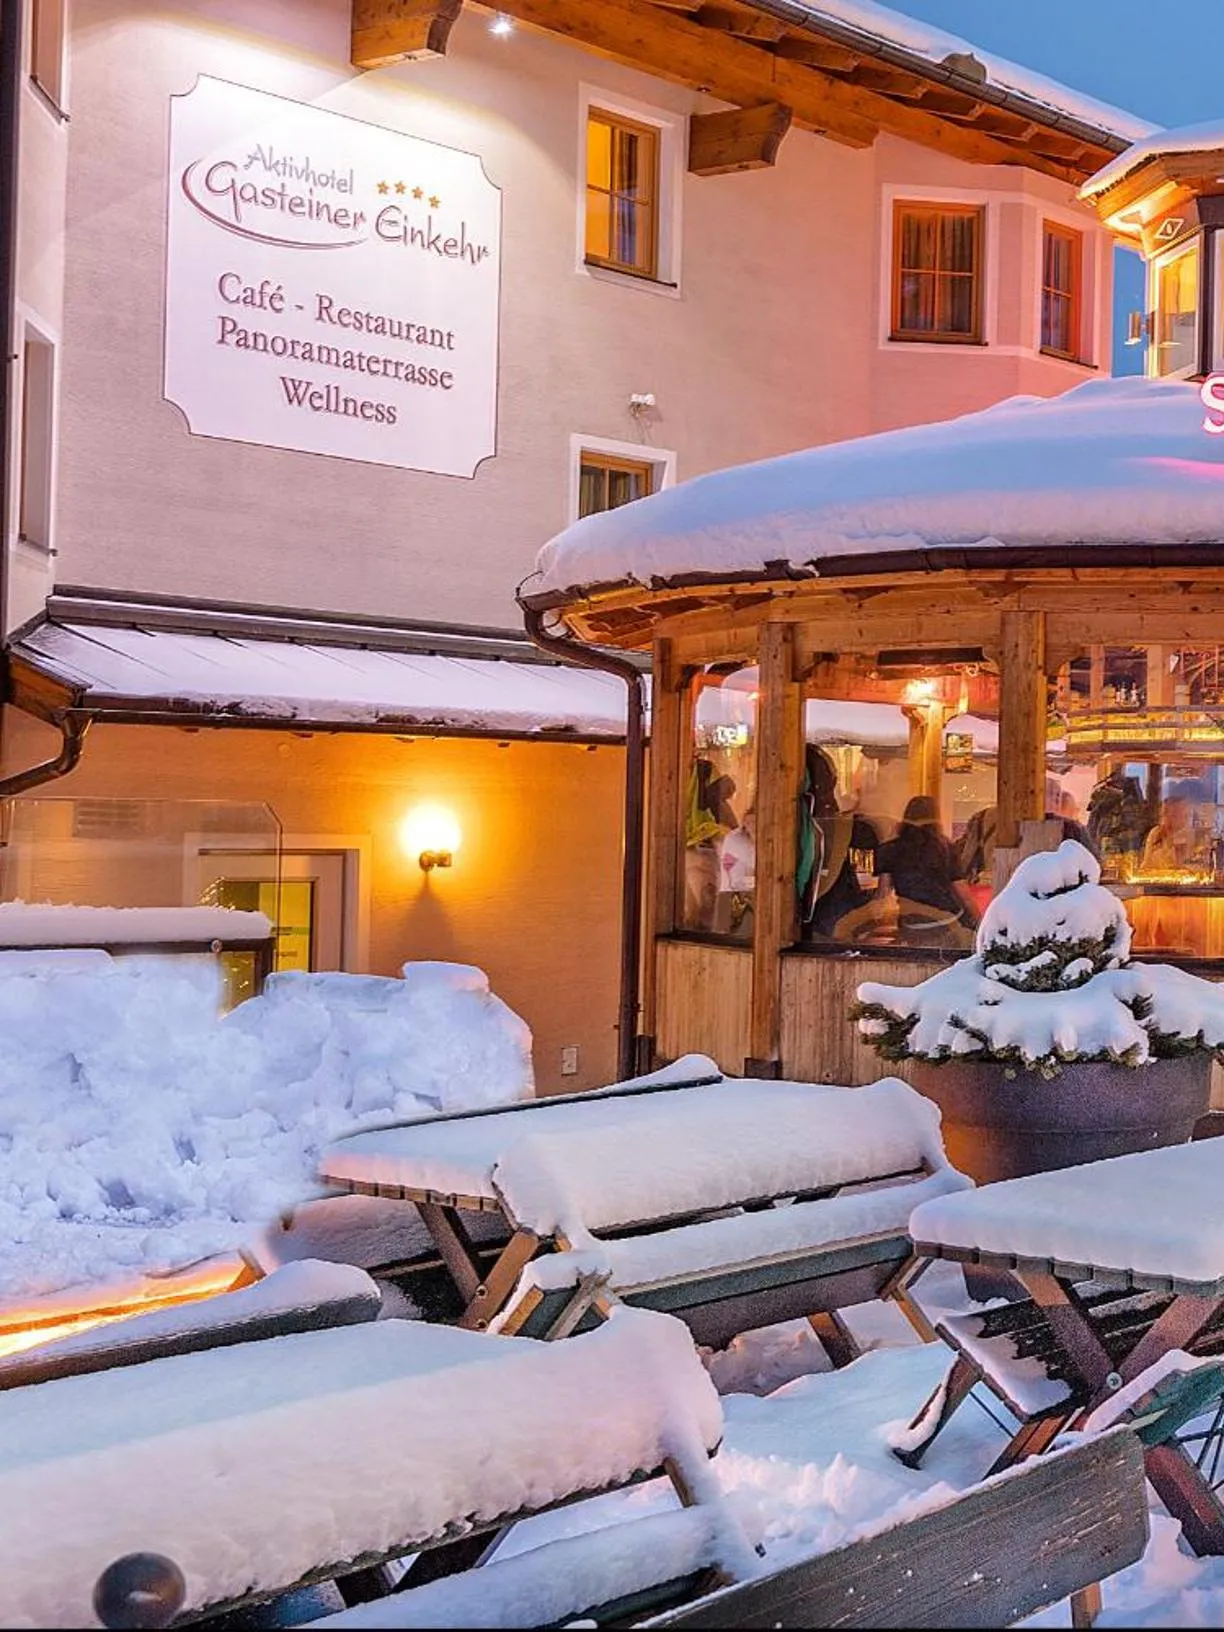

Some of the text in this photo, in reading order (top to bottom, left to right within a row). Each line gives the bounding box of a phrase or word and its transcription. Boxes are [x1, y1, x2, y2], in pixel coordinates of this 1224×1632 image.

[243, 143, 354, 195] Aktivhotel
[205, 161, 489, 265] Gasteiner Einkehr
[218, 272, 285, 314] Café
[316, 293, 455, 351] Restaurant
[216, 316, 454, 390] Panoramaterrasse
[281, 376, 397, 425] Wellness
